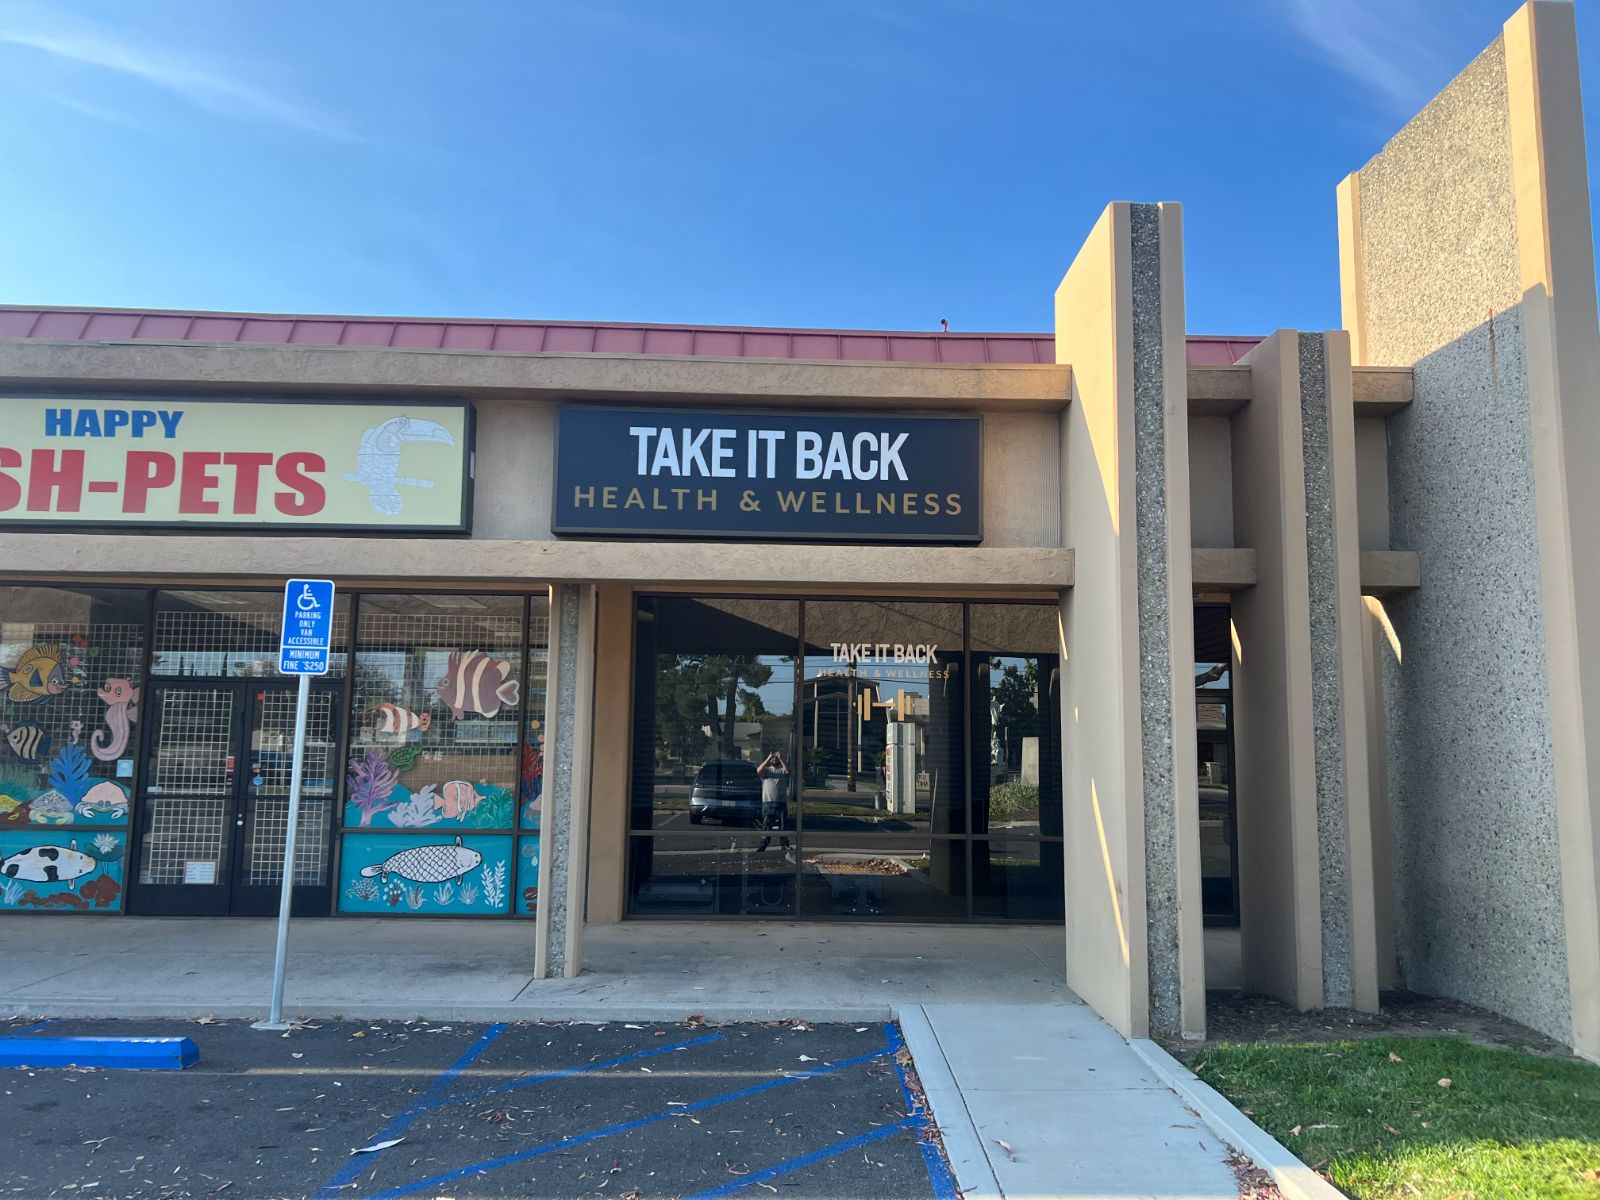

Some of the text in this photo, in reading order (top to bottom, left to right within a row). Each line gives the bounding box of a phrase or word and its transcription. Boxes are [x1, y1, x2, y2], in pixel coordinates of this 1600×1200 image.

[45, 408, 184, 439] HAPPY
[629, 426, 909, 481] TAKE IT BACK
[573, 485, 963, 516] HEALTH & WELLNESS
[295, 611, 321, 619] PARKING
[299, 620, 315, 628] ONLY
[288, 637, 324, 645] ACCESSIBLE
[290, 650, 320, 659] MINIMUM
[830, 643, 938, 664] TAKE IT BACK
[284, 661, 298, 669] FINE
[819, 668, 950, 679] HEALTH & WELLNESS
